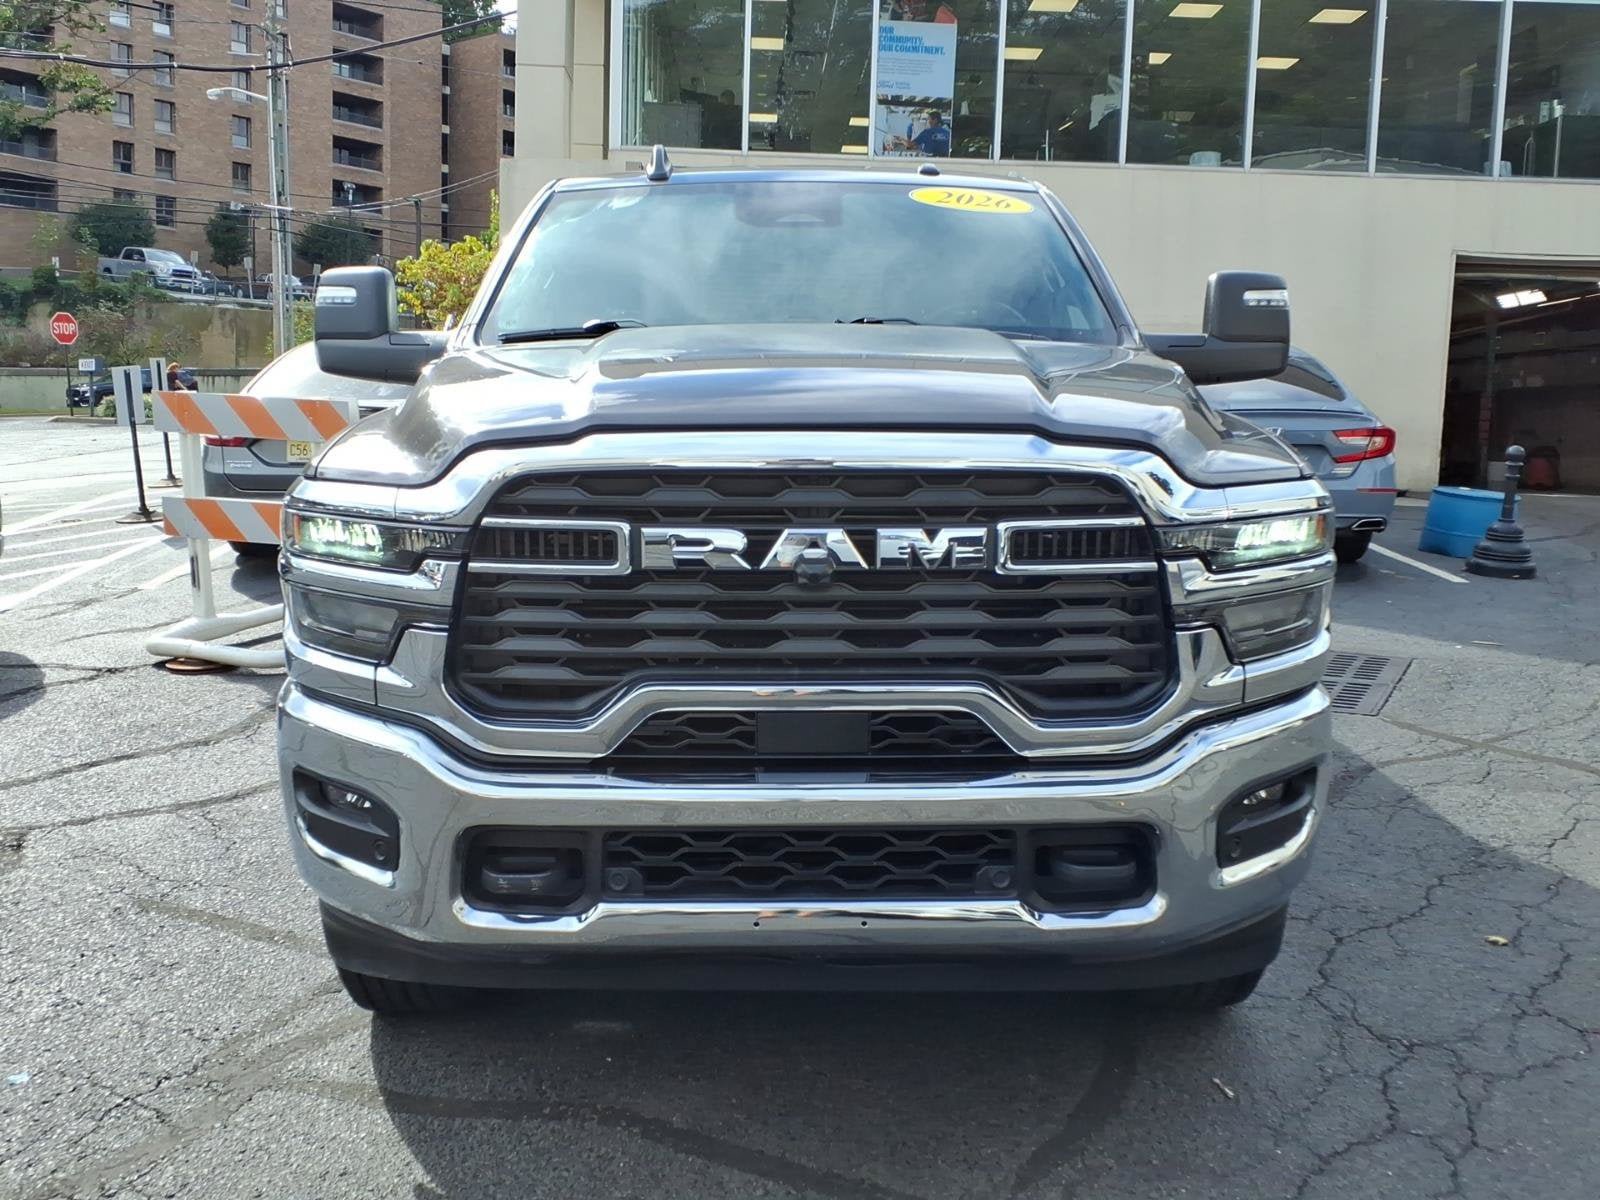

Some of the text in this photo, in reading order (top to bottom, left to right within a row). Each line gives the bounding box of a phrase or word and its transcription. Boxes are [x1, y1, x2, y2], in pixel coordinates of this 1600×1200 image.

[880, 26, 895, 34] OUR
[880, 43, 894, 52] OUR
[936, 191, 1011, 209] 2026
[53, 322, 75, 335] STOP
[641, 528, 988, 570] RAM
